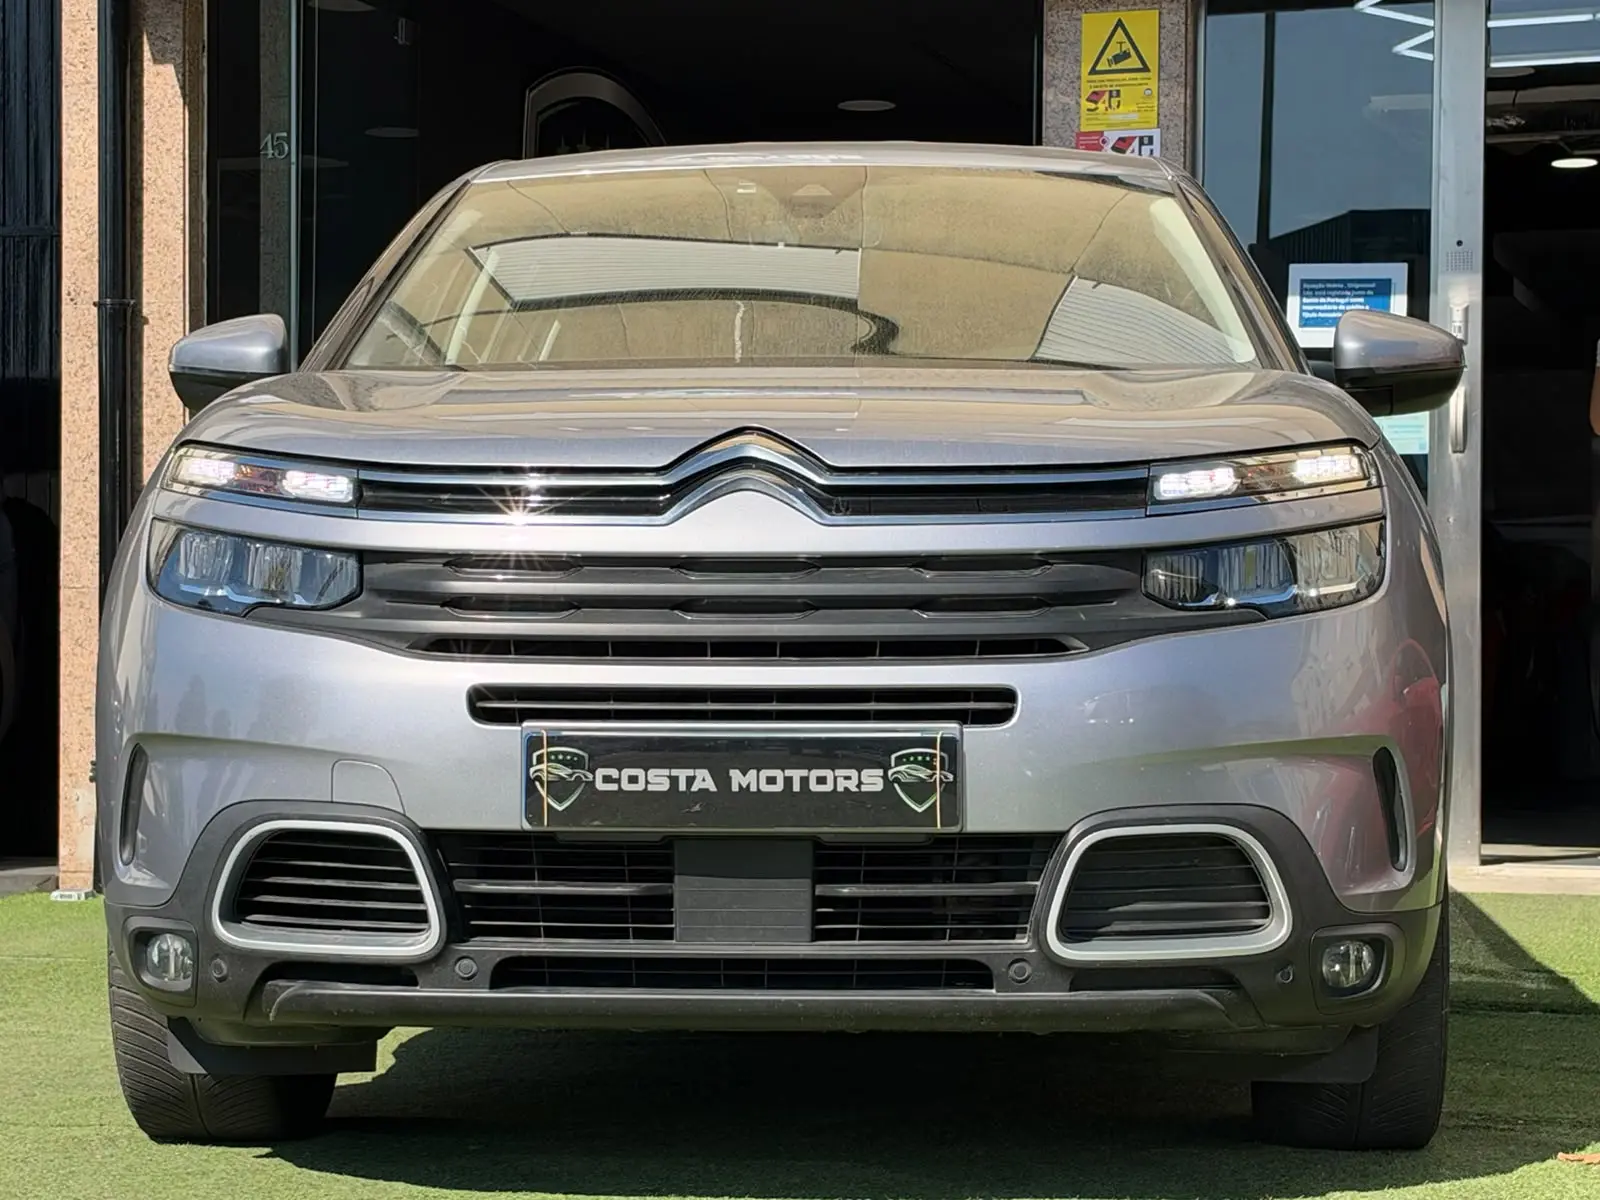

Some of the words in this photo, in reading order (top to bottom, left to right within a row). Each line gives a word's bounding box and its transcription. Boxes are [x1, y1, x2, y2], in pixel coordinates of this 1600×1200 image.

[259, 132, 289, 159] 45
[594, 767, 718, 792] COSTA
[729, 767, 884, 792] MOTORS
